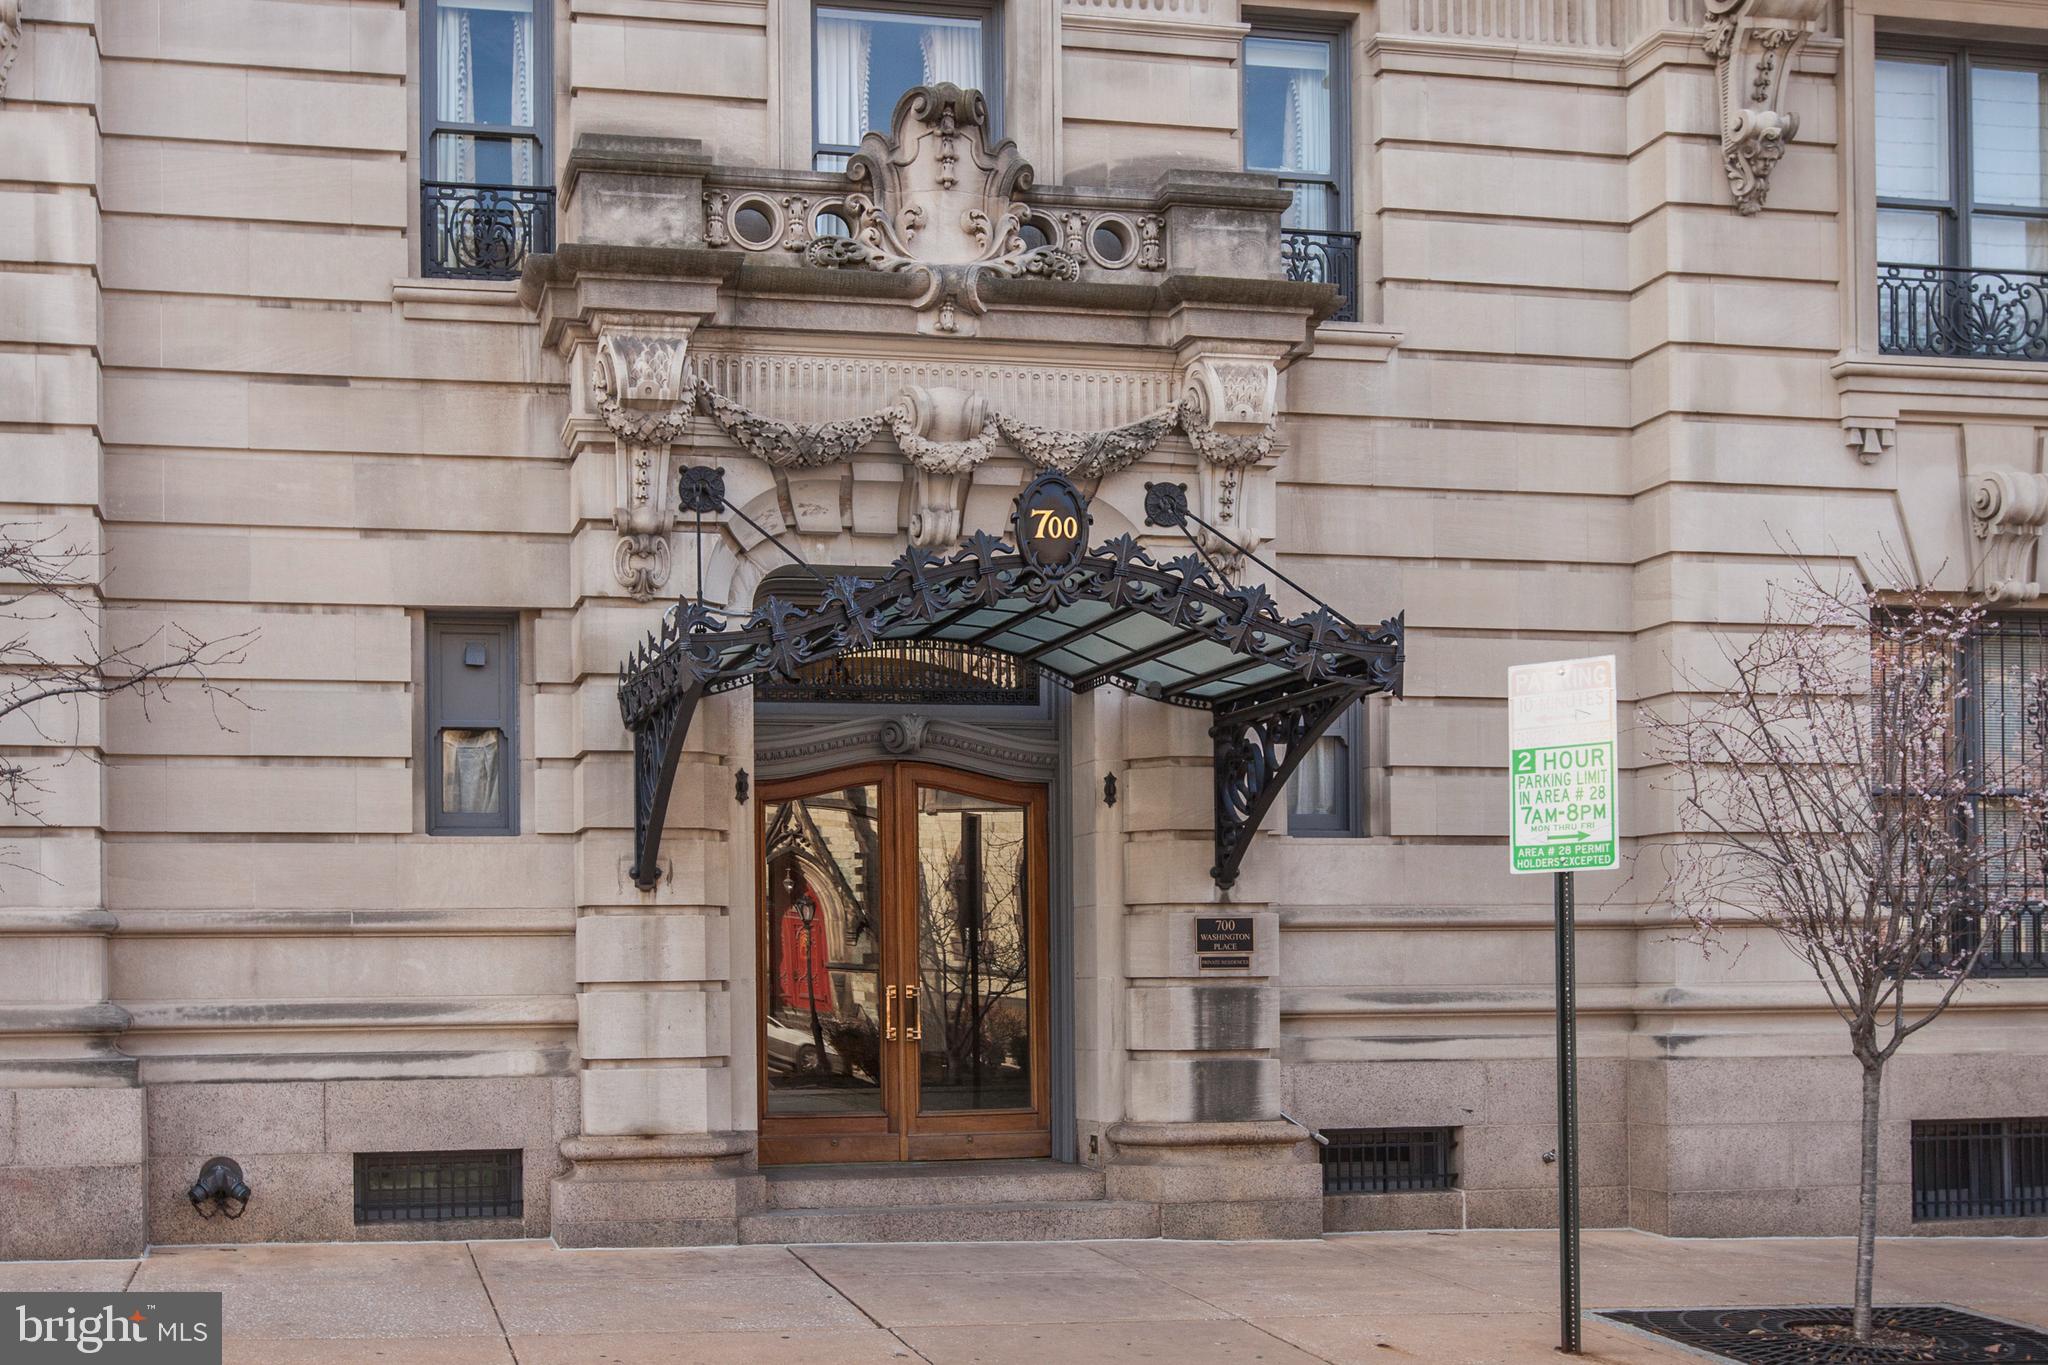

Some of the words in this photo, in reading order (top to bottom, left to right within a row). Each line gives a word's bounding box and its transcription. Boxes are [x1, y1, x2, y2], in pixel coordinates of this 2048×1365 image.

[1030, 508, 1078, 539] 700
[1514, 665, 1607, 694] PAKING
[1518, 751, 1532, 771] 2
[1543, 748, 1605, 771] HOUR
[1518, 771, 1572, 790] PARKING
[1576, 768, 1608, 786] LIMIT
[1519, 790, 1530, 806] IN
[1535, 788, 1570, 804] AREA
[1575, 786, 1585, 801] #
[1589, 785, 1606, 801] 28
[1520, 803, 1606, 825] 7AM-8PM
[1530, 824, 1550, 833] MON
[1553, 823, 1578, 832] THRU
[1580, 821, 1595, 829] FRI
[1518, 847, 1545, 858] AREA
[1547, 846, 1555, 857] #
[1559, 845, 1572, 856] 28
[1574, 843, 1611, 855] PERMIT
[1517, 858, 1560, 869] HOLDERS
[1562, 854, 1612, 868] EXCEPTED
[1215, 919, 1236, 931] 700
[1200, 933, 1251, 941] WASHINGTON
[1213, 943, 1238, 951] PLACE
